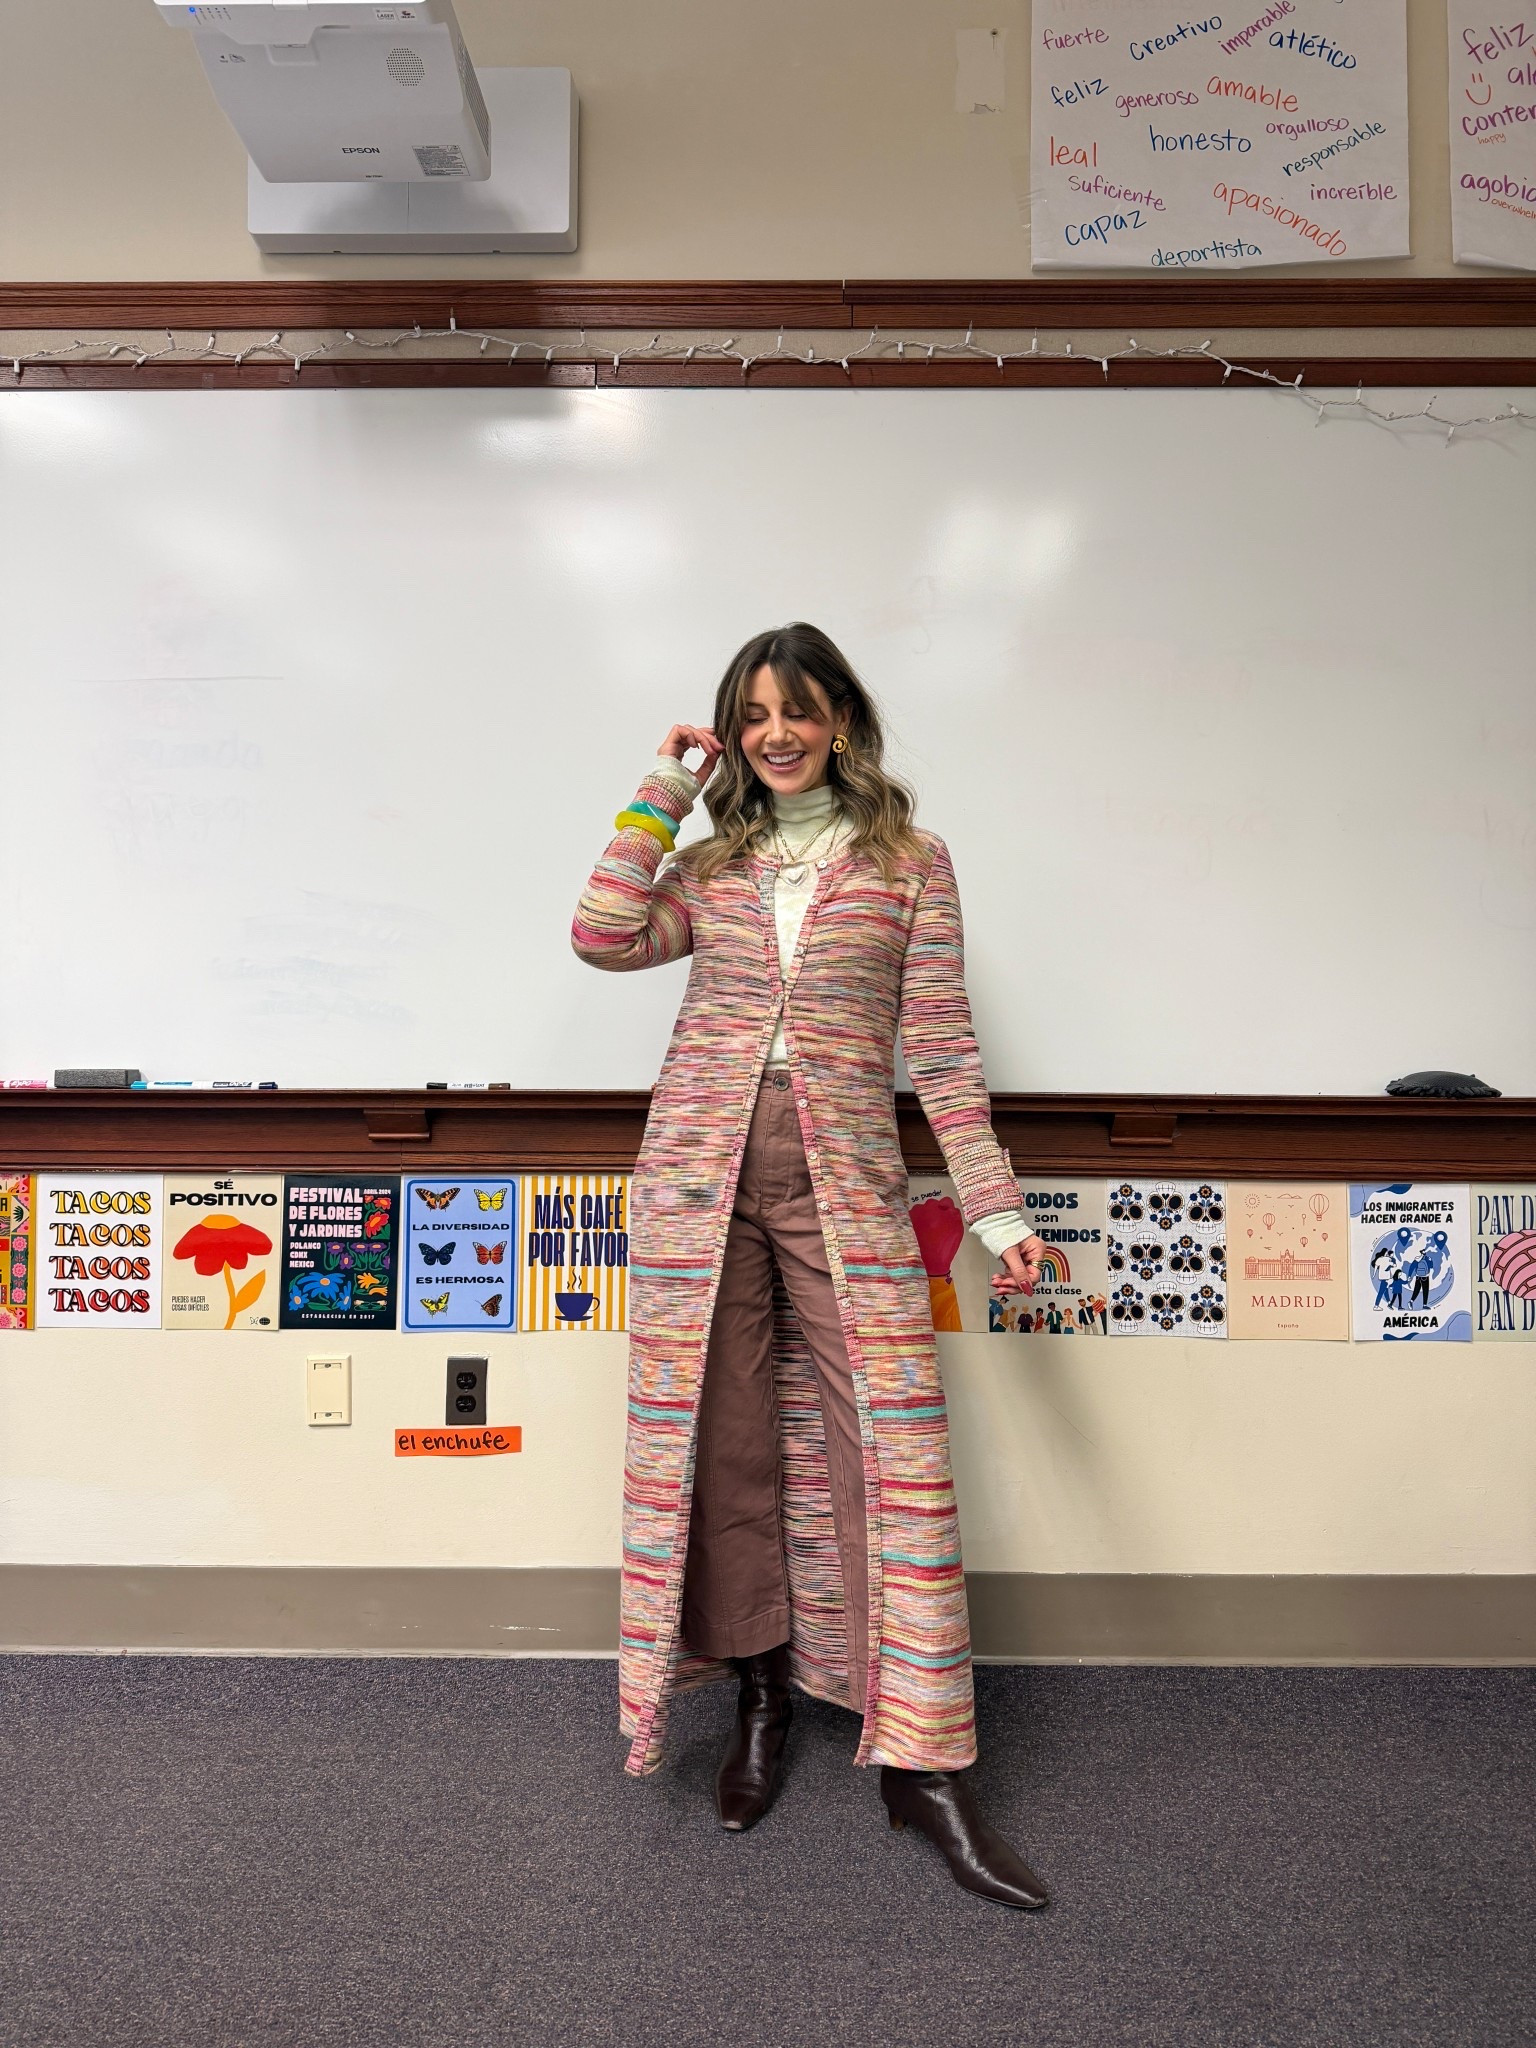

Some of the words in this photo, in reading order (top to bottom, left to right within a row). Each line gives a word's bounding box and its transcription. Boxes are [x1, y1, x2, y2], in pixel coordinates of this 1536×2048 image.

[1043, 26, 1110, 51] fuerte
[1218, 0, 1297, 55] imparable
[1462, 22, 1535, 65] feliz
[1050, 78, 1110, 108] feliz
[1115, 91, 1199, 118] generoso
[1206, 74, 1299, 113] amable
[1149, 124, 1252, 153] honesto
[1265, 116, 1350, 141] orgulloso
[1477, 132, 1507, 146] happy
[1050, 136, 1099, 168] leal
[1282, 120, 1387, 176] responsable
[1064, 209, 1148, 248] capaz
[1213, 181, 1348, 257] apasionado
[1151, 237, 1263, 267] deportista
[213, 1178, 234, 1190] SÉ
[289, 1187, 363, 1203] FESTIVAL
[50, 1190, 152, 1214] TACOS
[169, 1193, 278, 1207] POSITIVO
[534, 1186, 575, 1230] MÁS
[580, 1186, 624, 1230] CAFÉ
[1022, 1192, 1079, 1209] ODOS
[1362, 1201, 1382, 1212] LOS
[1385, 1201, 1455, 1212] INMIGRANTES
[289, 1205, 307, 1220] DE
[309, 1205, 363, 1221] FLORES
[1034, 1214, 1059, 1223] son
[1361, 1213, 1396, 1224] HACEN
[1399, 1213, 1442, 1224] GRANDE
[1445, 1213, 1454, 1223] A
[1477, 1195, 1515, 1235] PAN
[49, 1223, 151, 1247] TACOS
[288, 1223, 298, 1237] Y
[299, 1223, 363, 1238] JARDINES
[412, 1223, 430, 1231] LA
[432, 1223, 510, 1231] DIVERSIDAD
[289, 1241, 322, 1250] POLANCO
[528, 1231, 566, 1267] POR
[570, 1231, 629, 1268] FAVOR
[48, 1255, 151, 1280] TACOS
[415, 1276, 433, 1285] ES
[435, 1276, 505, 1284] HERMOSA
[1032, 1286, 1052, 1295] sta
[1054, 1284, 1082, 1295] clase
[47, 1287, 151, 1313] TACOS
[1250, 1295, 1326, 1308] MADRID
[1477, 1290, 1516, 1331] PAN
[1382, 1313, 1439, 1329] AMÉRICA
[398, 1434, 416, 1451] el
[421, 1430, 511, 1451] enchufe
